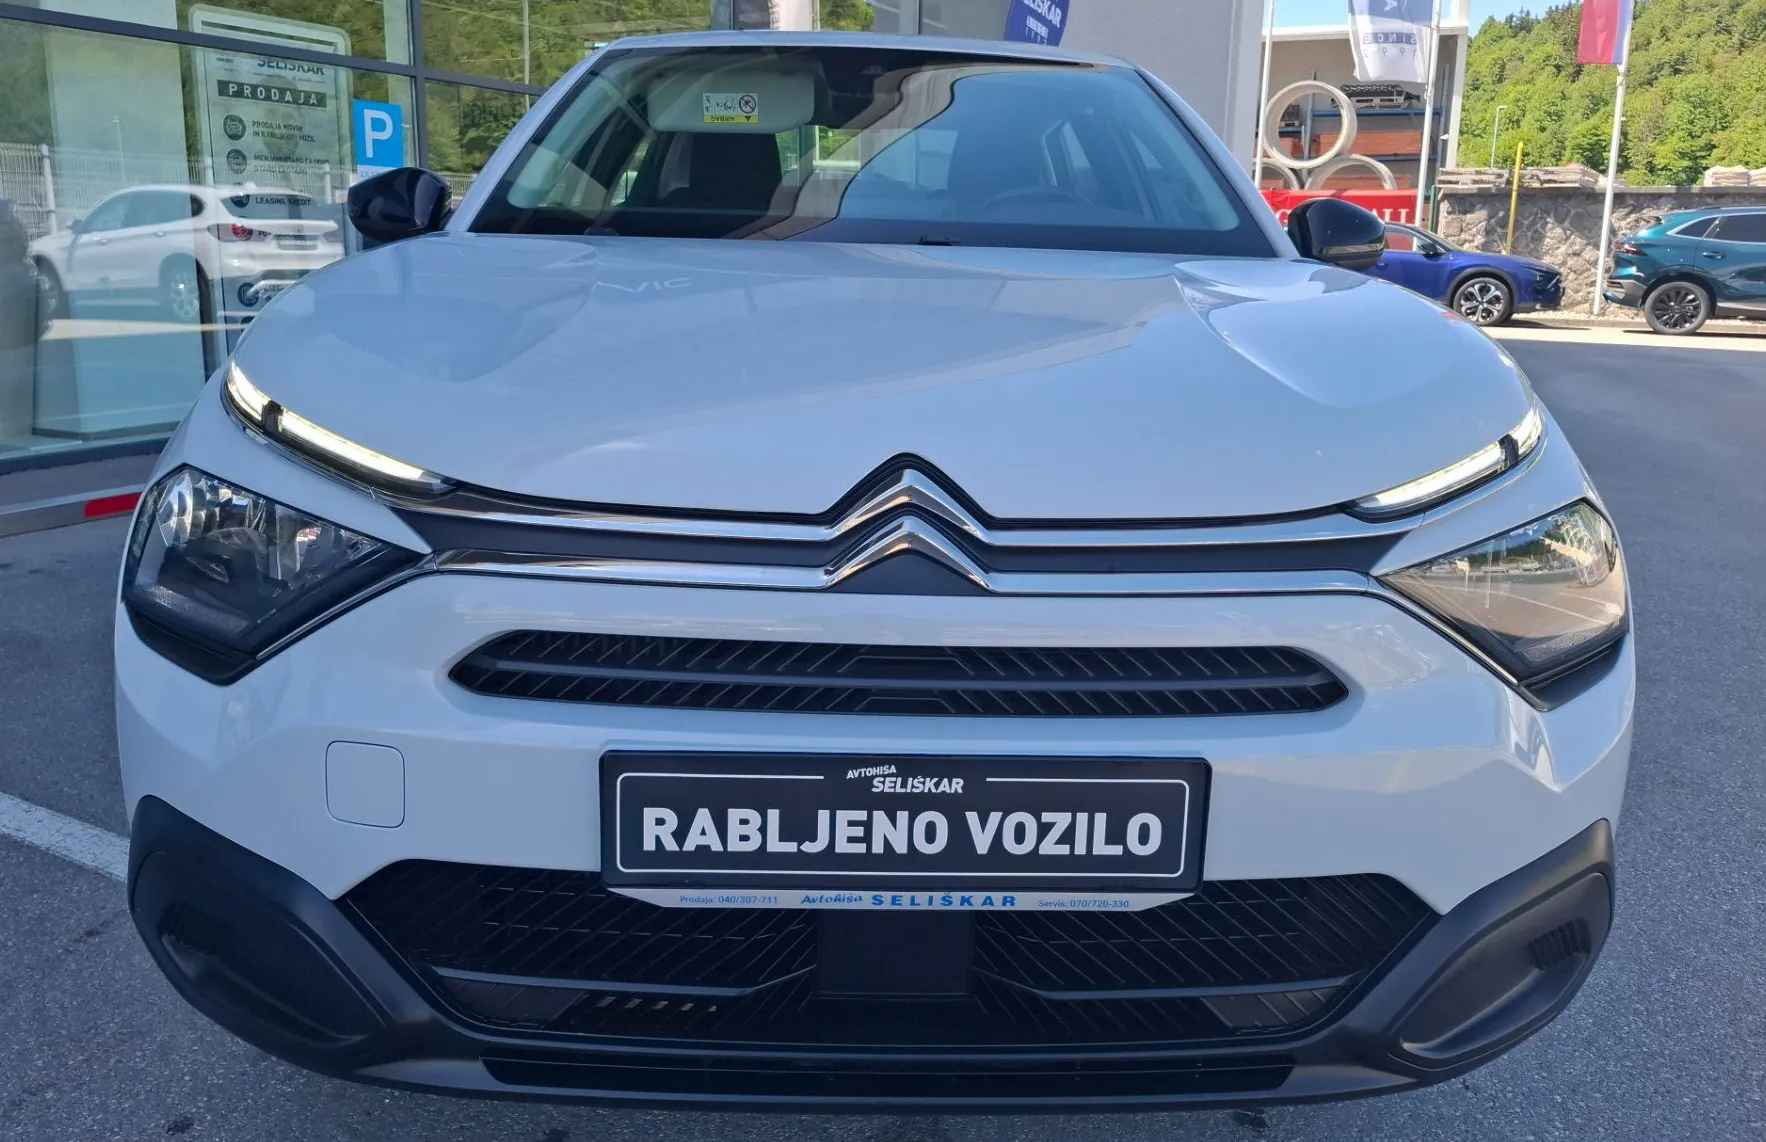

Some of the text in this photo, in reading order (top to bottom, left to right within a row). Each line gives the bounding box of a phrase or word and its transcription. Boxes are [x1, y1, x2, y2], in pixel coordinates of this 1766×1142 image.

[228, 83, 318, 106] PRODAJA
[251, 120, 282, 130] PRODAJA
[363, 108, 394, 158] P
[846, 764, 897, 780] AVTOHIŠA
[871, 776, 965, 794] SELIŠKAR
[642, 807, 1163, 856] RABLJENO VOZILO
[679, 895, 778, 905] Prodaja: 040/307-711
[800, 892, 1017, 908] Avtohiša SELIŠKAR
[1038, 899, 1130, 909] Servis: 070/720-330
